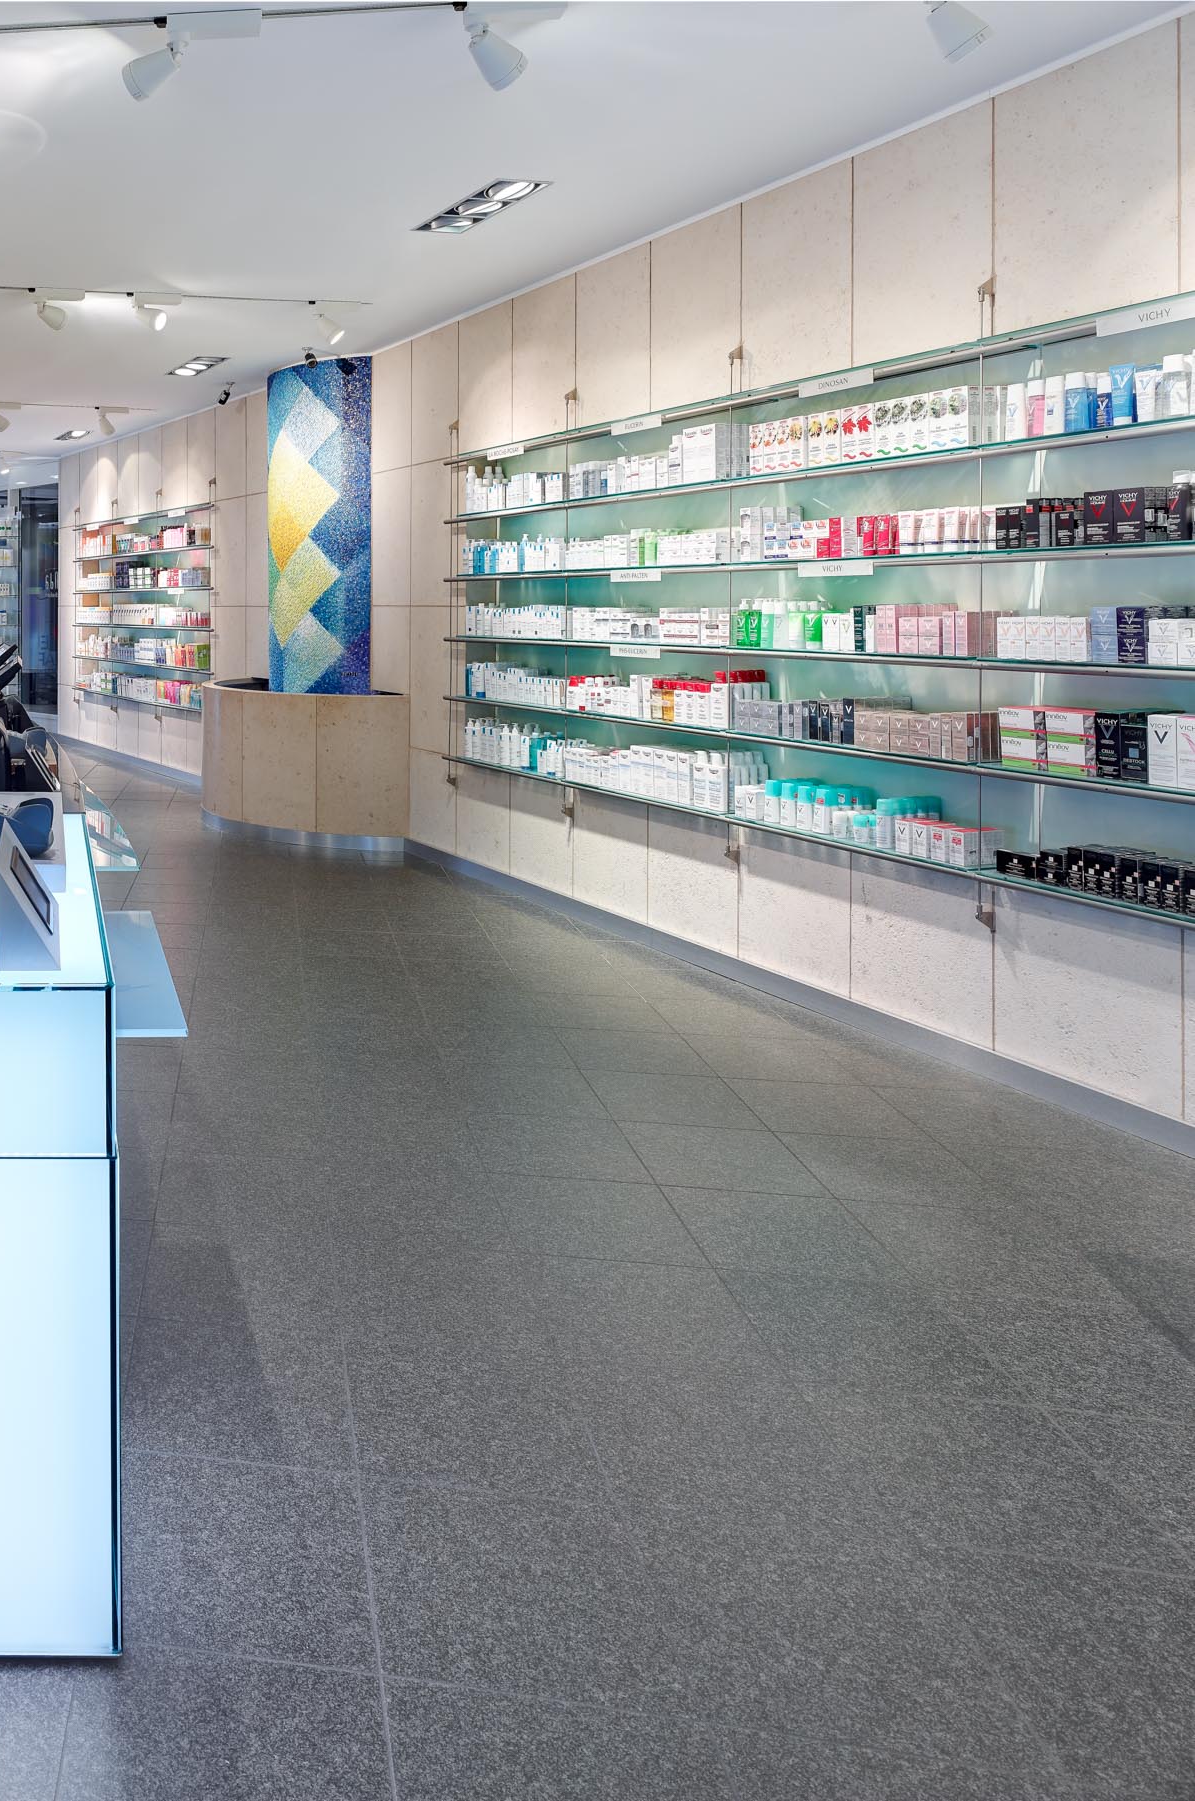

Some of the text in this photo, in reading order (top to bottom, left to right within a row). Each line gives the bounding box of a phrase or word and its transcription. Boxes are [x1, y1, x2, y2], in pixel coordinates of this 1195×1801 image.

[1138, 308, 1171, 323] VICHY
[818, 376, 849, 390] DINOSAN
[822, 565, 843, 573] VICHY
[1096, 717, 1118, 725] VICHY
[1150, 722, 1173, 730] VICHY
